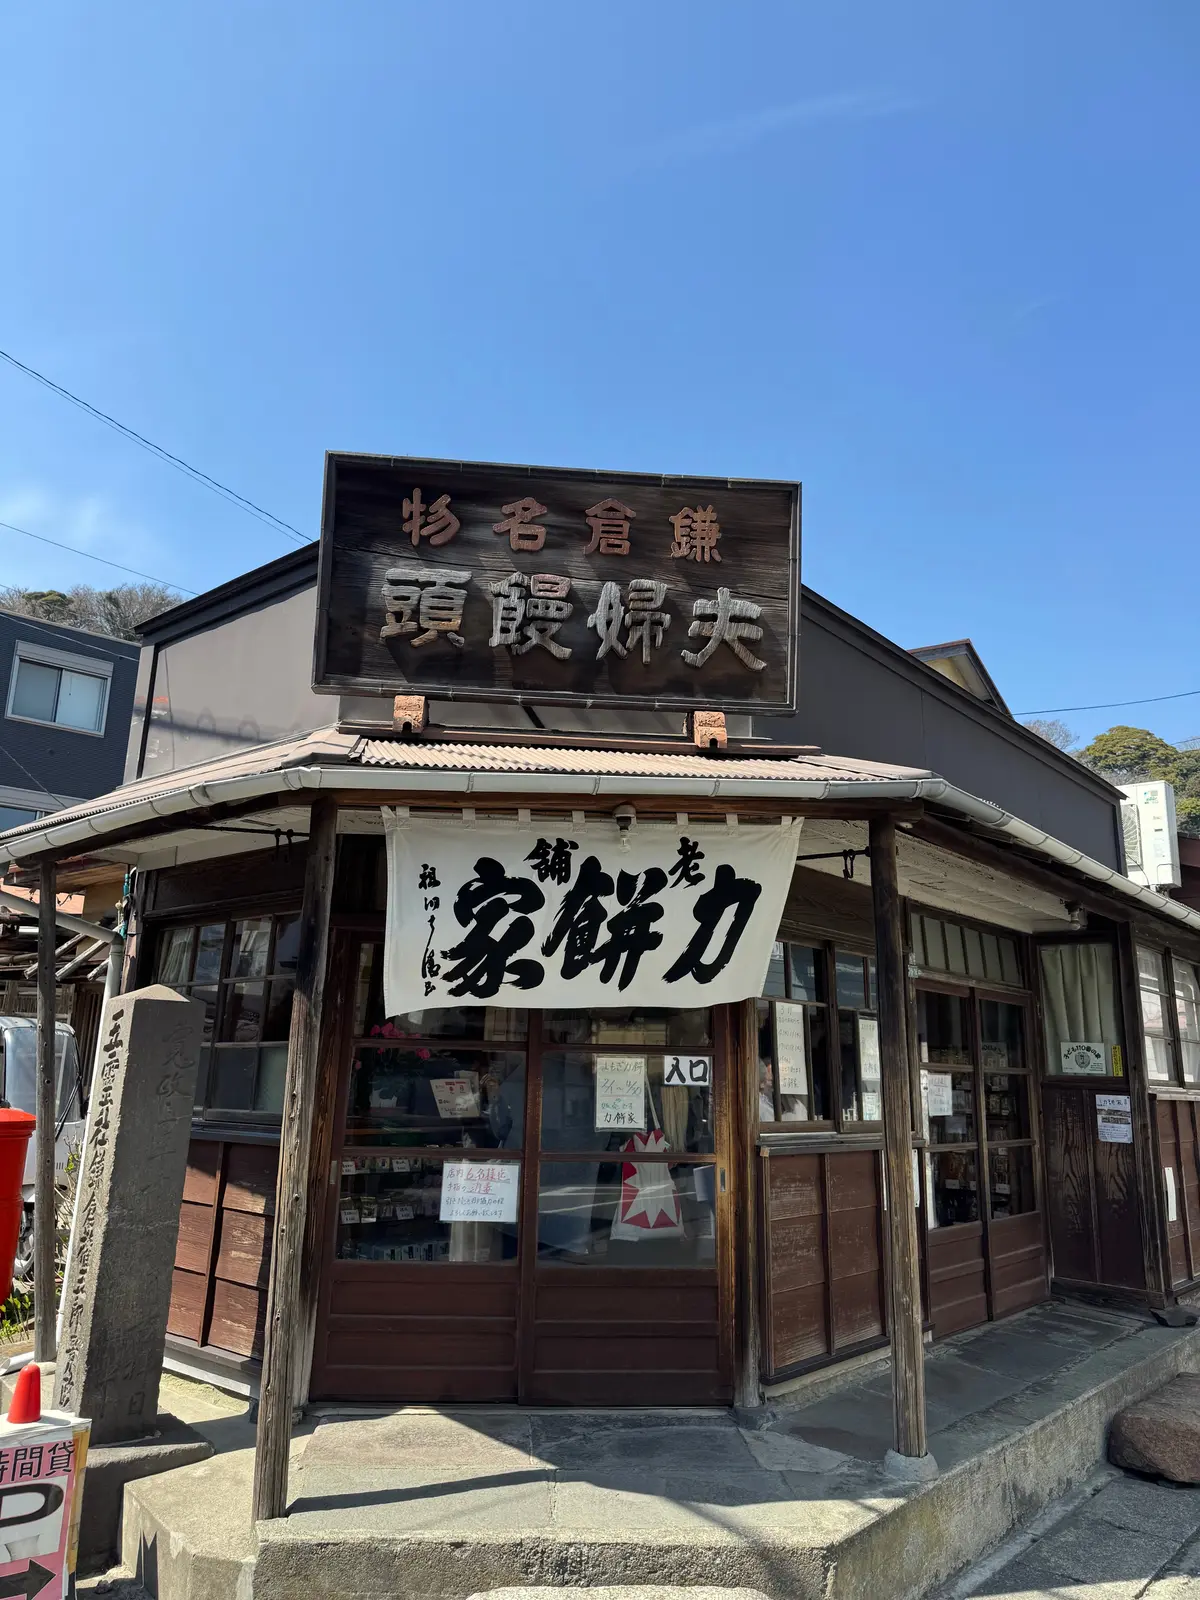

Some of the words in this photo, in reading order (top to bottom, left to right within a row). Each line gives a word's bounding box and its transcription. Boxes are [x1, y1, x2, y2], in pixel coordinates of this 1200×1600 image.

[1063, 1045, 1102, 1060] 子ども110番の家
[665, 1057, 709, 1083] 入口
[604, 1112, 639, 1125] 力餅家
